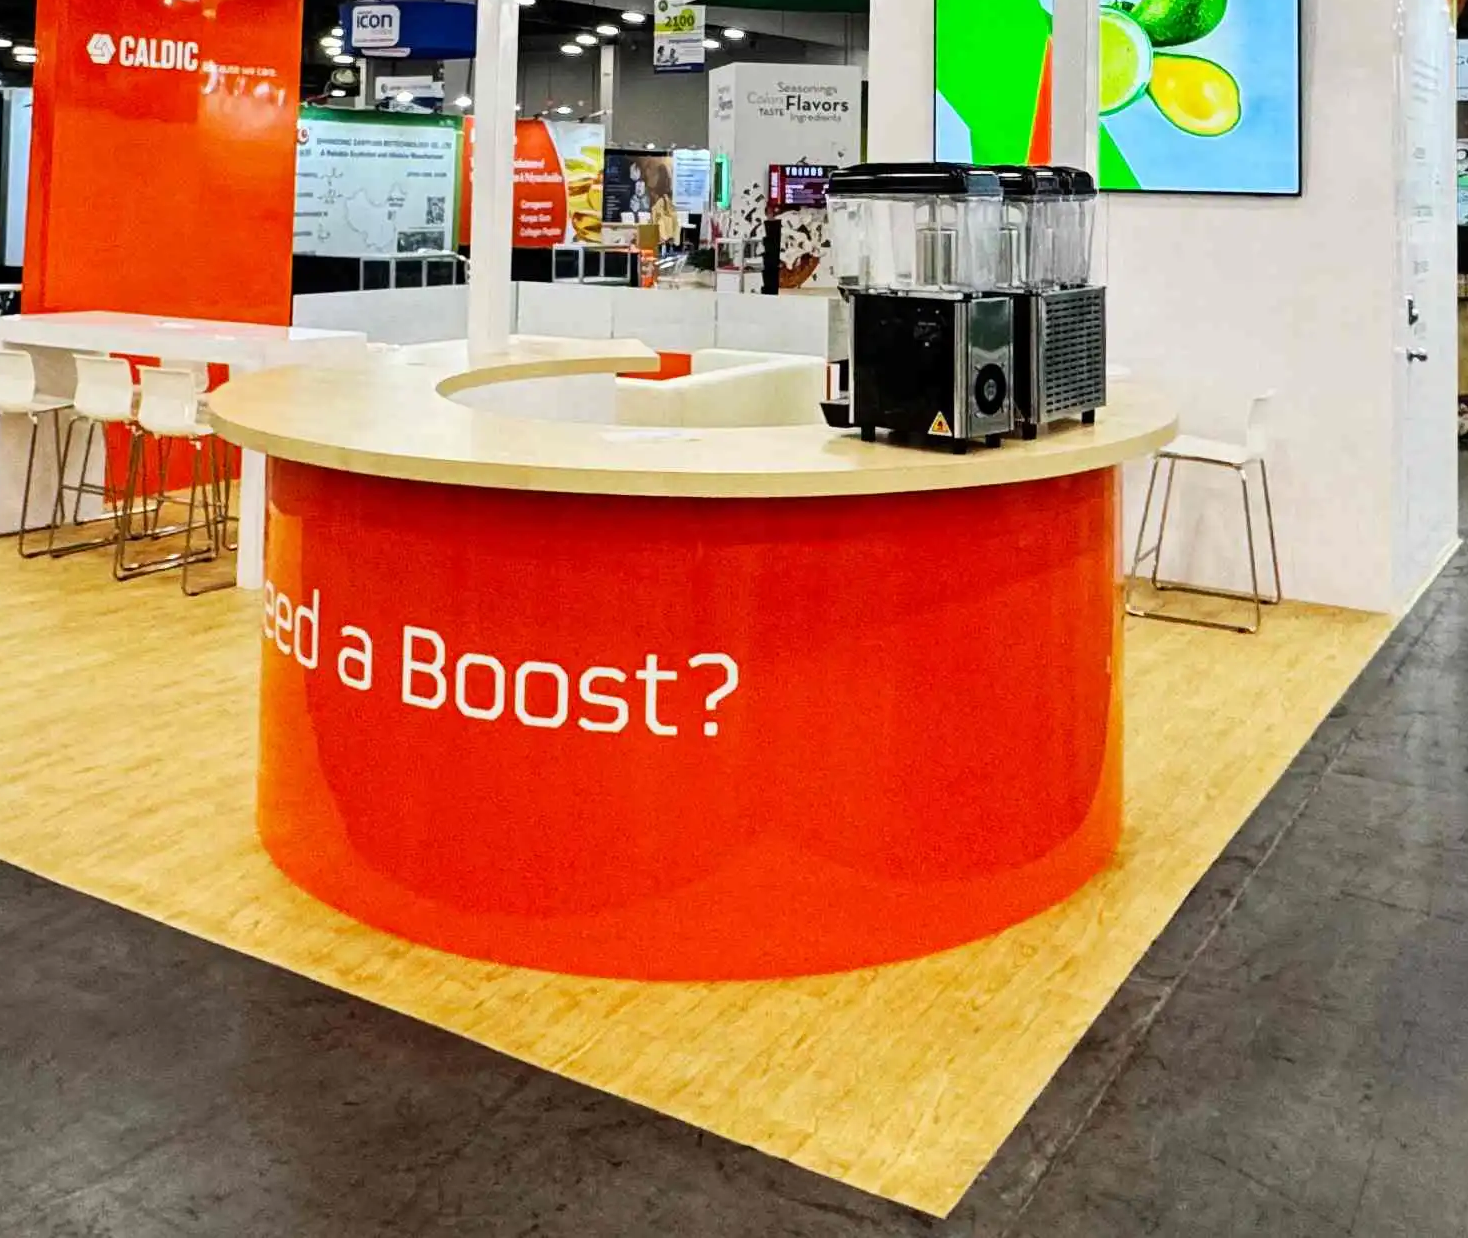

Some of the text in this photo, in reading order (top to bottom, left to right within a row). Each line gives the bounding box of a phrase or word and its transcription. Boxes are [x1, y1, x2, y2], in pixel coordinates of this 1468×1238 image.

[356, 12, 393, 29] icon
[119, 35, 199, 72] CALDIC
[778, 82, 838, 95] Seasonings
[759, 108, 785, 117] TASTE
[786, 96, 850, 113] Flavors
[263, 580, 741, 737] eed a Boost?
